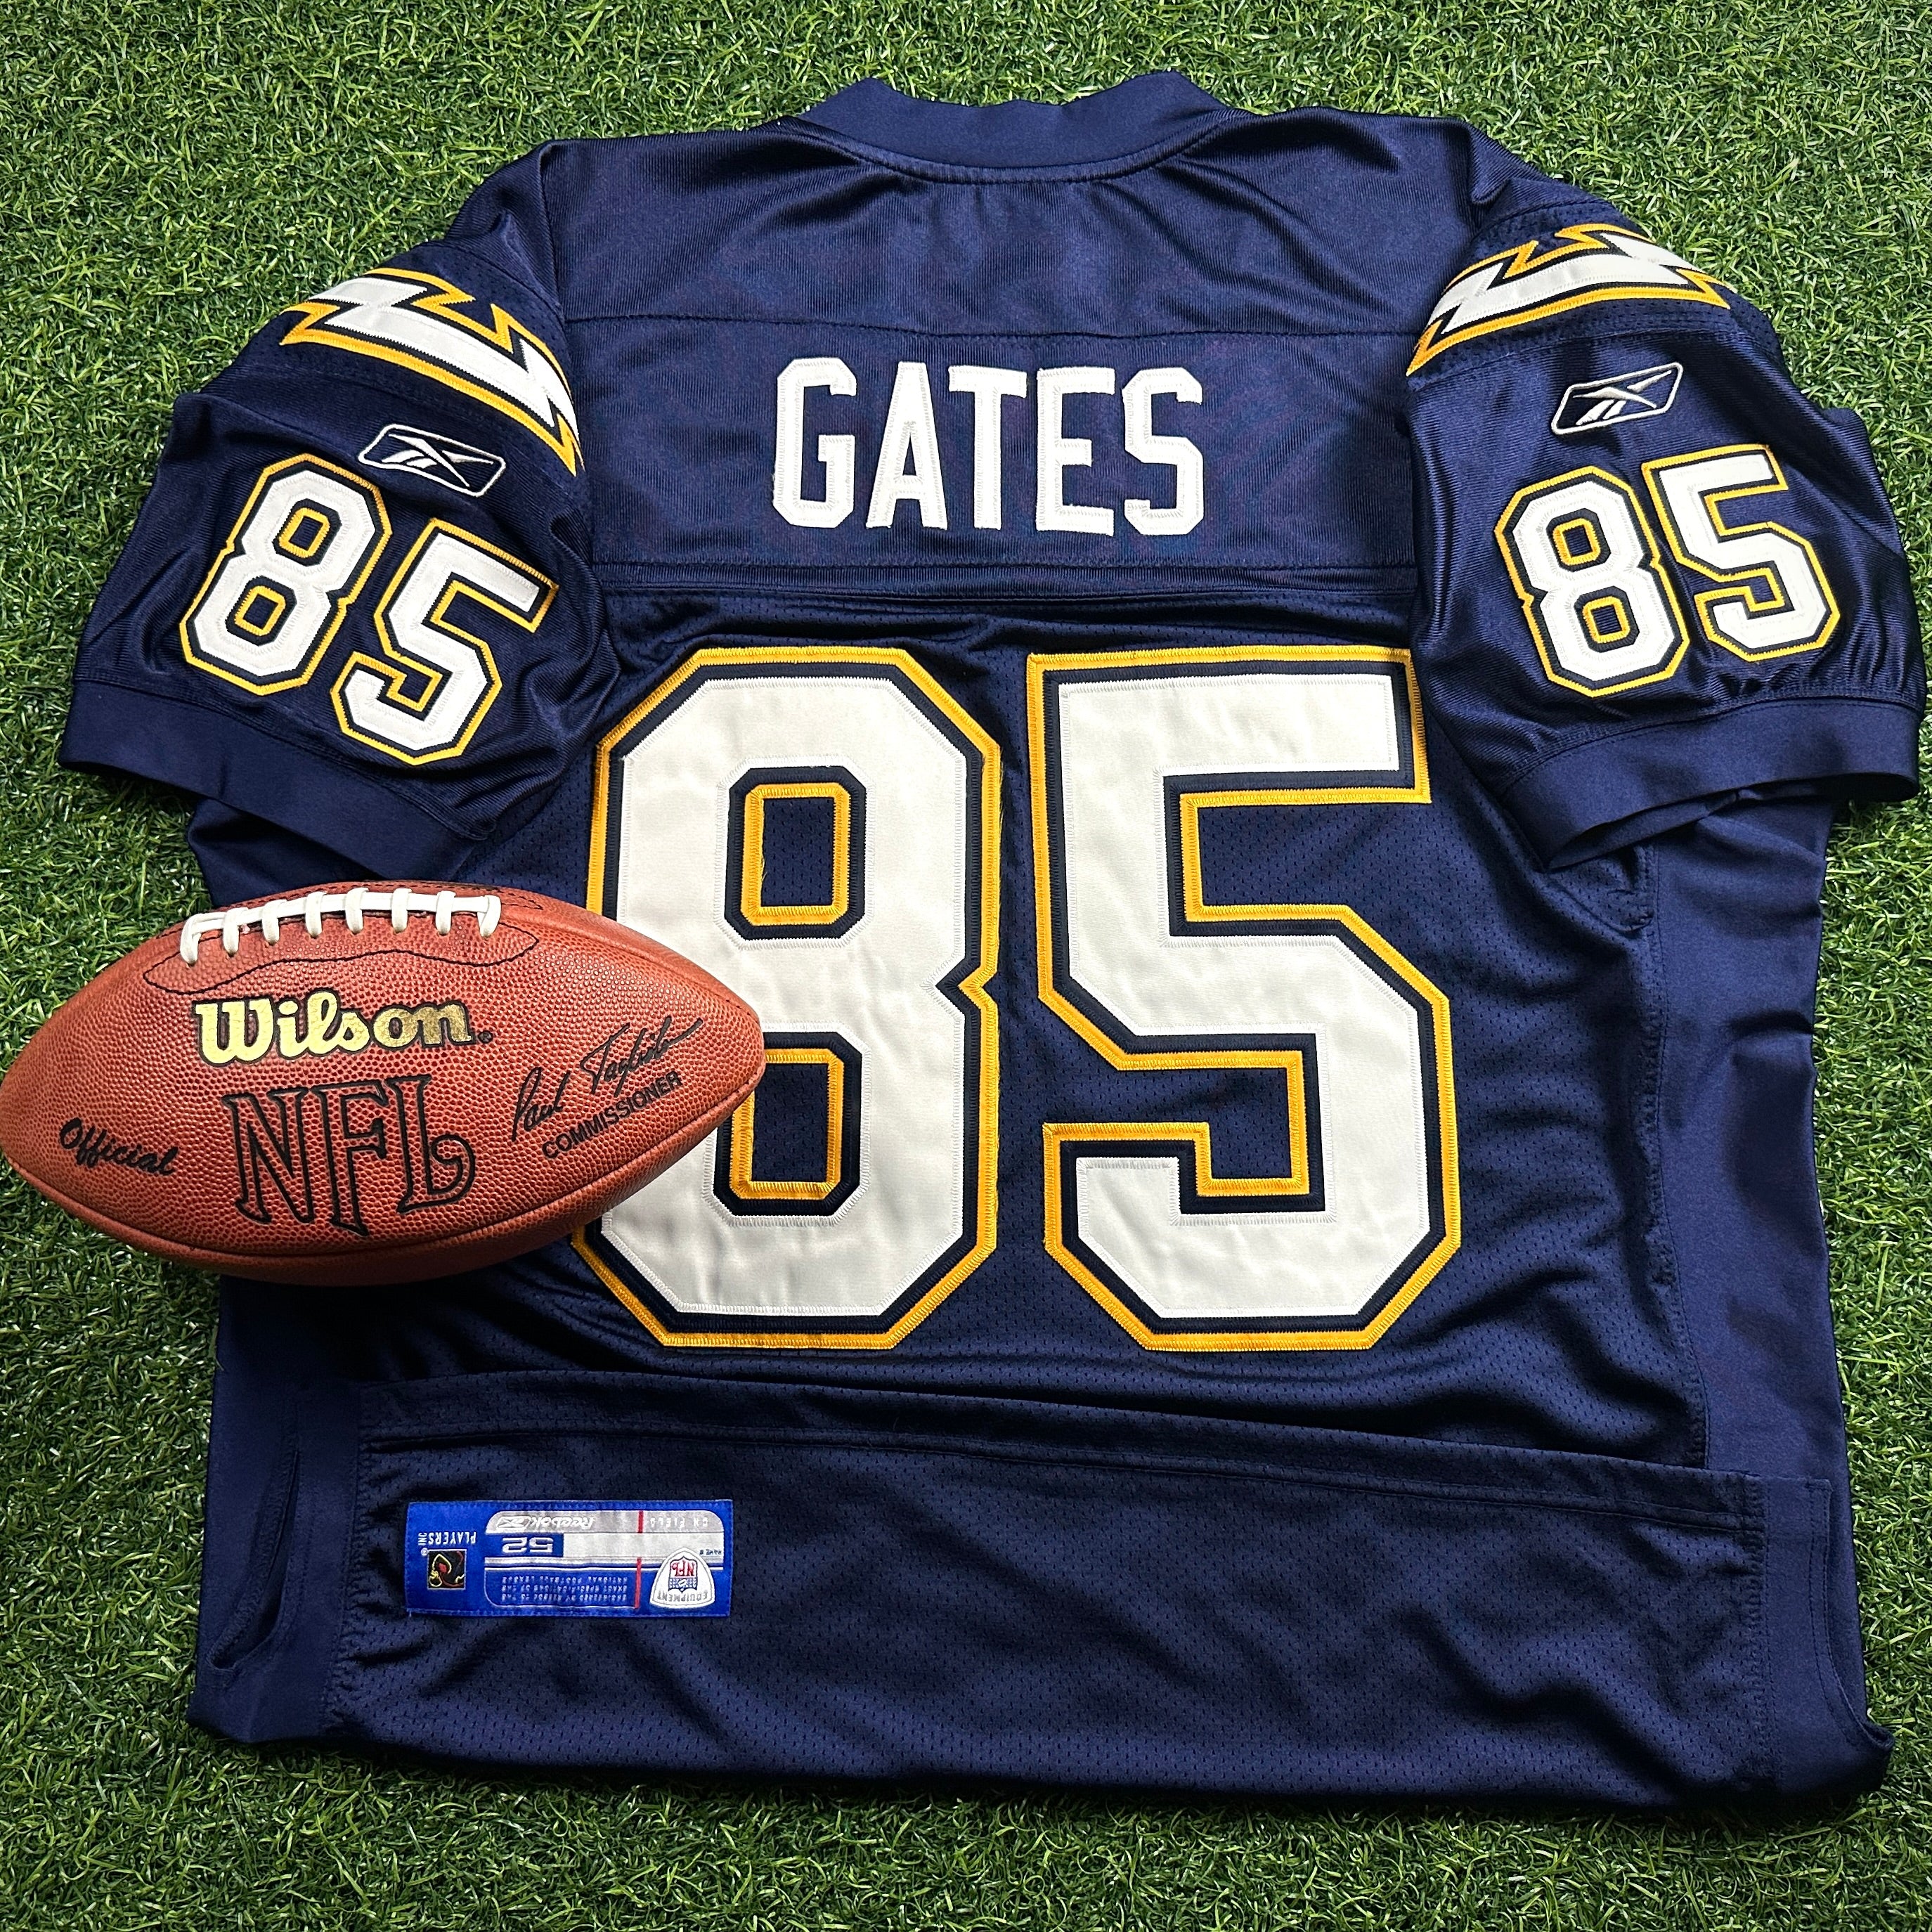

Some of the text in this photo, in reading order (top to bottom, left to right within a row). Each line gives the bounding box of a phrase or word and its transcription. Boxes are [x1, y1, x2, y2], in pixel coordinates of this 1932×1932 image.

[773, 356, 1204, 536] GATES
[1494, 443, 1841, 697] 85
[179, 453, 559, 765] 85
[192, 987, 472, 1066] Wilson
[571, 645, 1461, 1351] 85
[60, 1117, 180, 1176] Official
[542, 1070, 682, 1159] COMMISSIONER
[222, 1074, 476, 1236] NFL
[418, 1533, 427, 1545] INC
[429, 1532, 476, 1545] PLAYERS
[503, 1538, 553, 1552] 52
[530, 1517, 595, 1529] Reebok
[657, 1591, 708, 1602] EQUIPMENT
[670, 1560, 695, 1576] NFL
